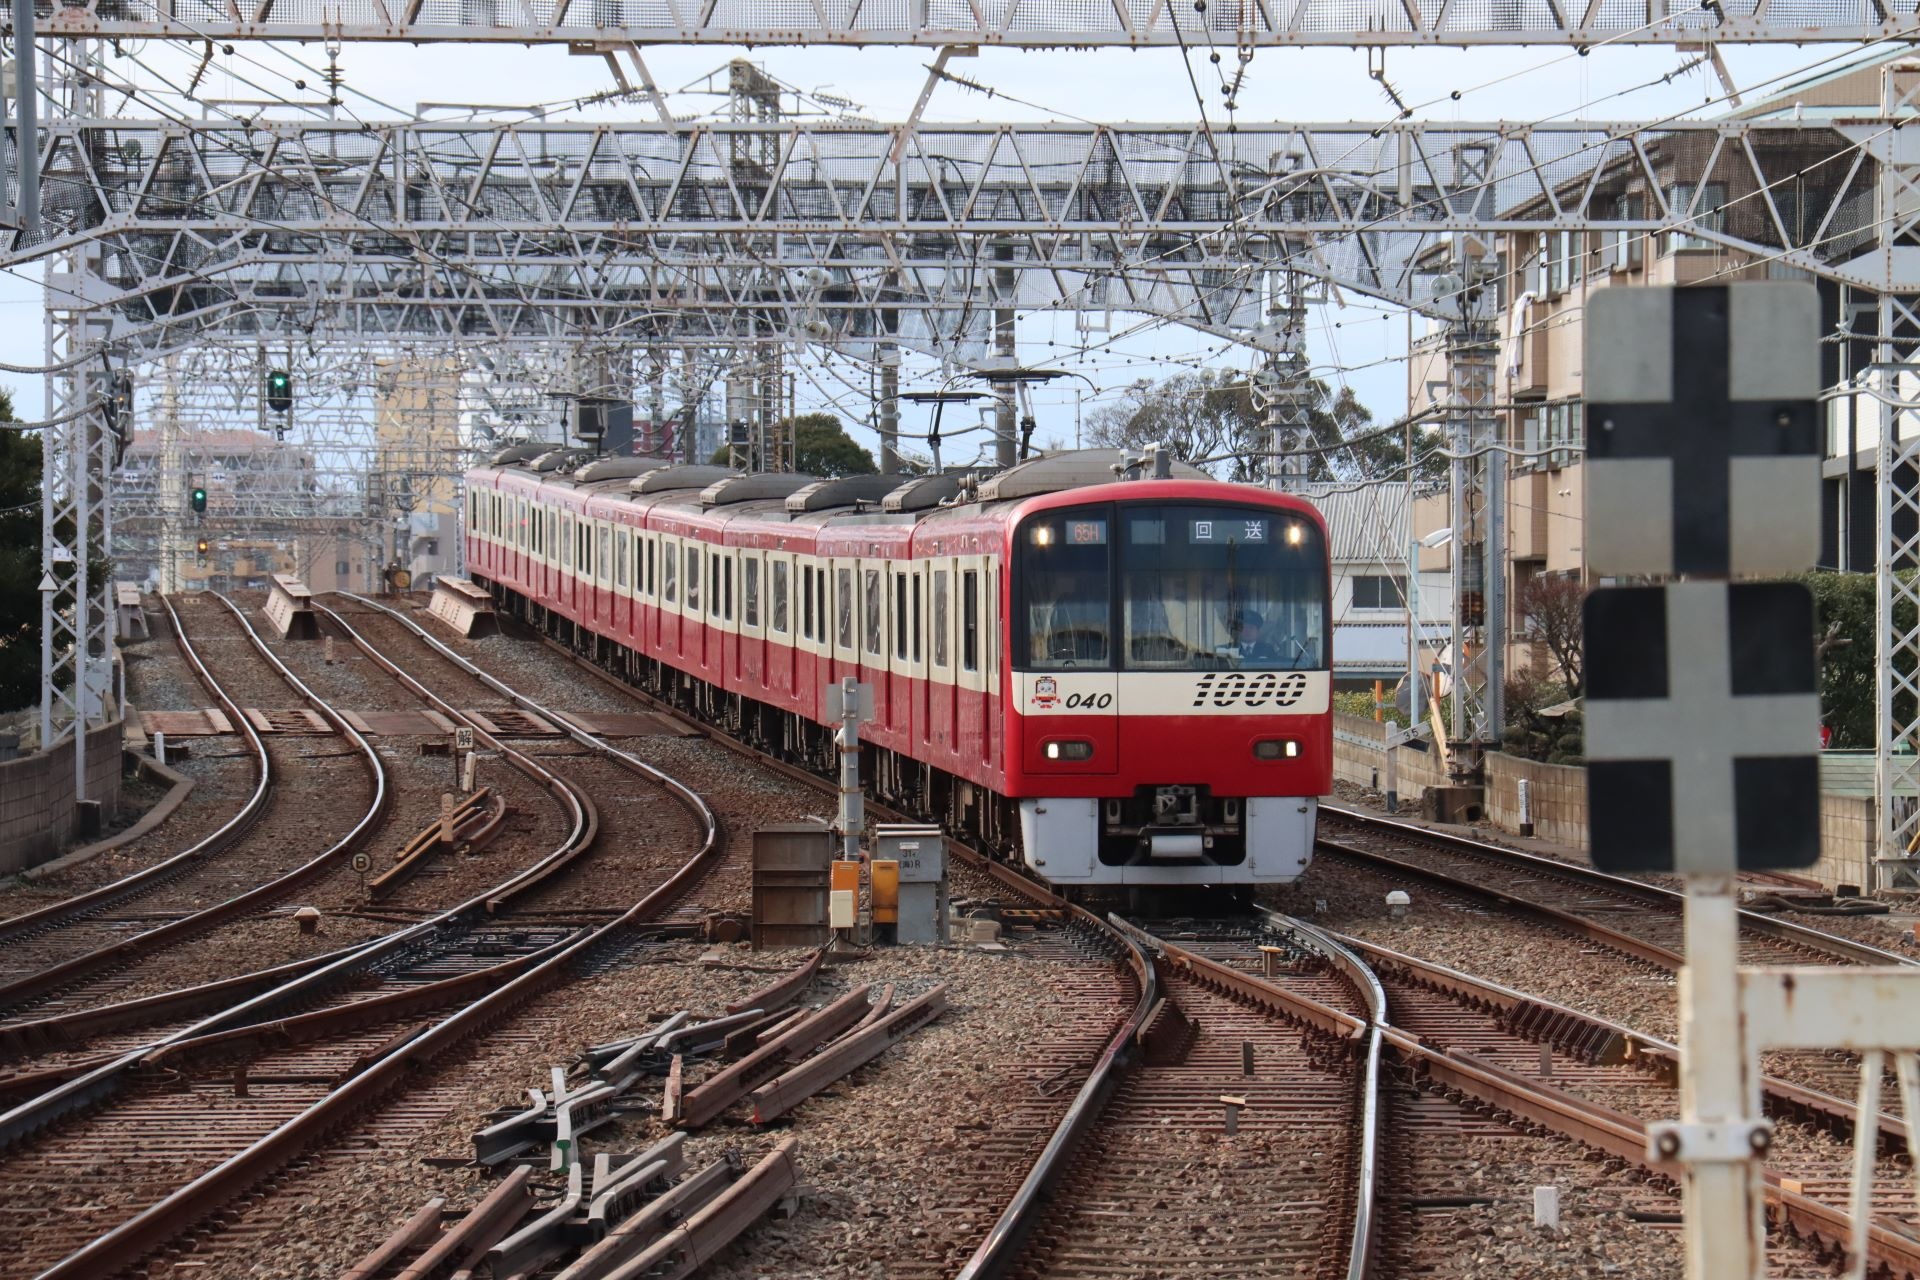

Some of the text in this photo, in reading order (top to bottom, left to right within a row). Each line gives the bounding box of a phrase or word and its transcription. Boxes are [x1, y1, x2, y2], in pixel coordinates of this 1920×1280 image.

[1195, 521, 1263, 539] 回送
[1193, 673, 1306, 707] 1000
[1066, 693, 1112, 709] 040
[457, 730, 472, 746] 解
[1403, 728, 1419, 740] 35
[355, 856, 368, 869] B
